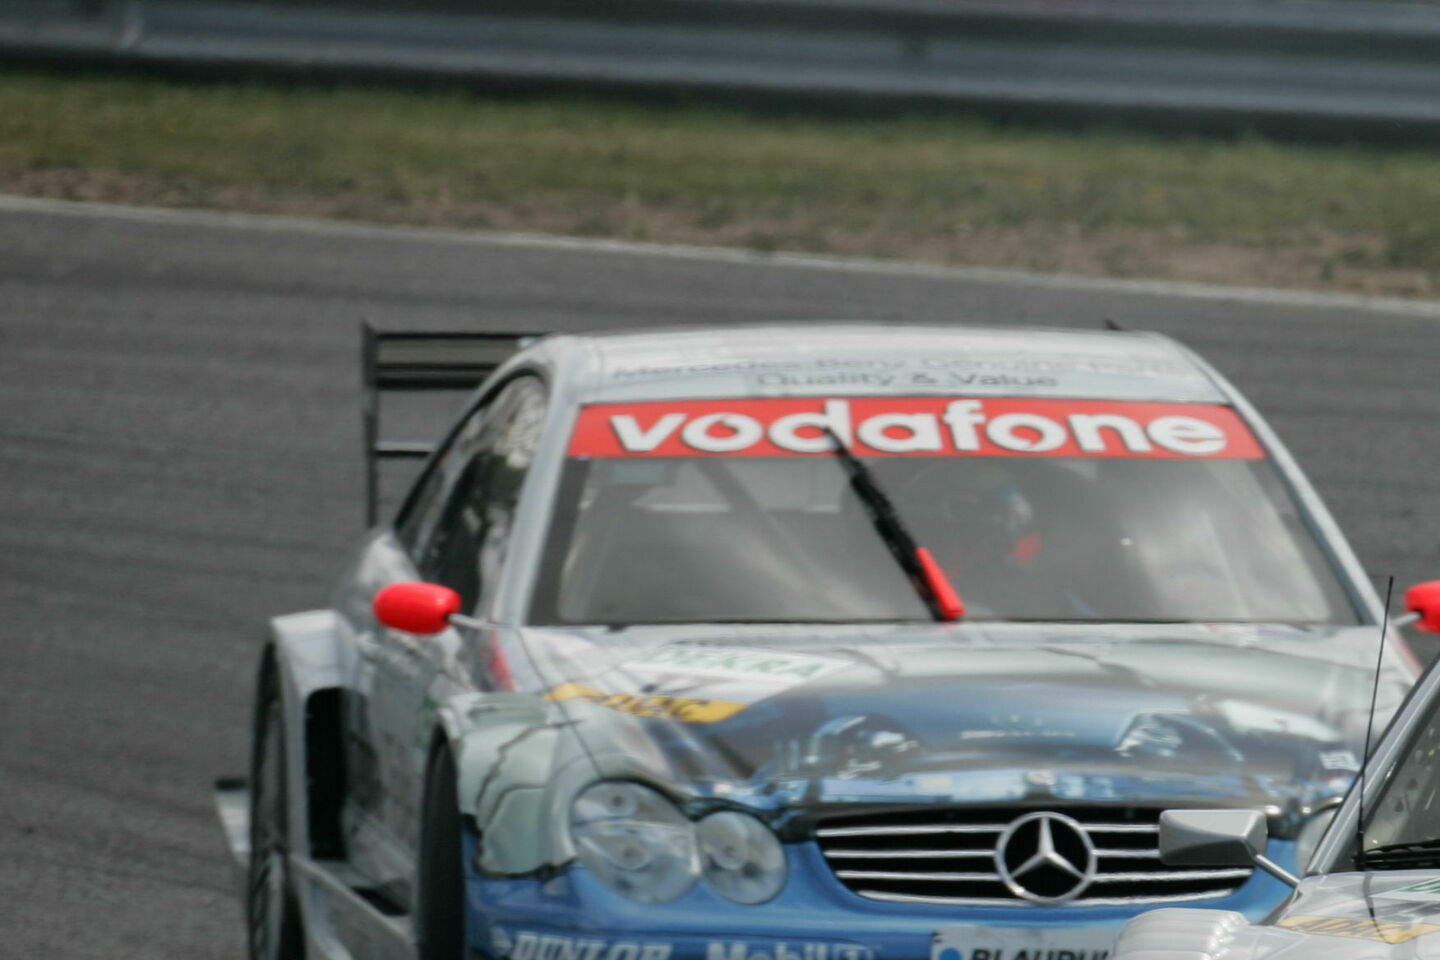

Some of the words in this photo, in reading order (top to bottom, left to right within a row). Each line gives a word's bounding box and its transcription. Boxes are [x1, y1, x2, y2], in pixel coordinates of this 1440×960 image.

[757, 371, 896, 388] Quality
[910, 373, 937, 386] &
[951, 372, 1058, 388] Value
[609, 399, 1227, 455] vodafone
